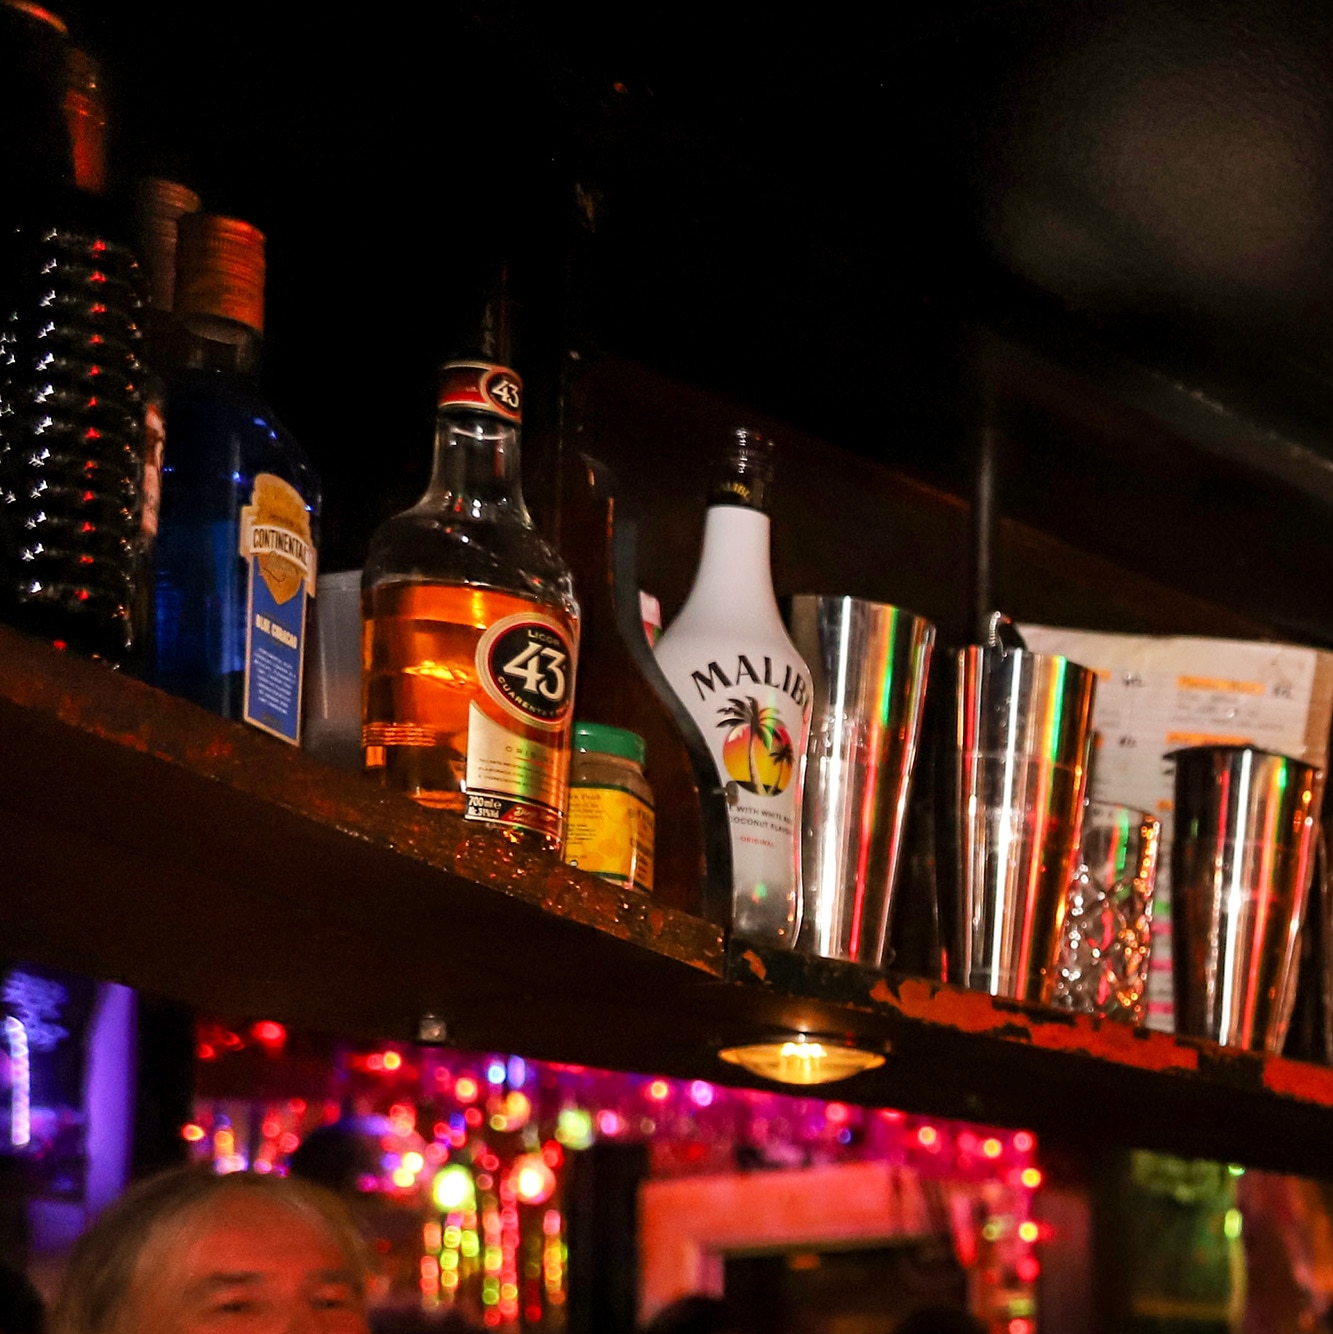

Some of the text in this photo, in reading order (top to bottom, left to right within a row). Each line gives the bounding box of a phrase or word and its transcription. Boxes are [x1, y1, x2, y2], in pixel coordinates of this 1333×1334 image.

[492, 380, 519, 408] 43
[527, 629, 560, 647] LICOR
[502, 640, 567, 702] 43
[737, 805, 760, 815] WITH
